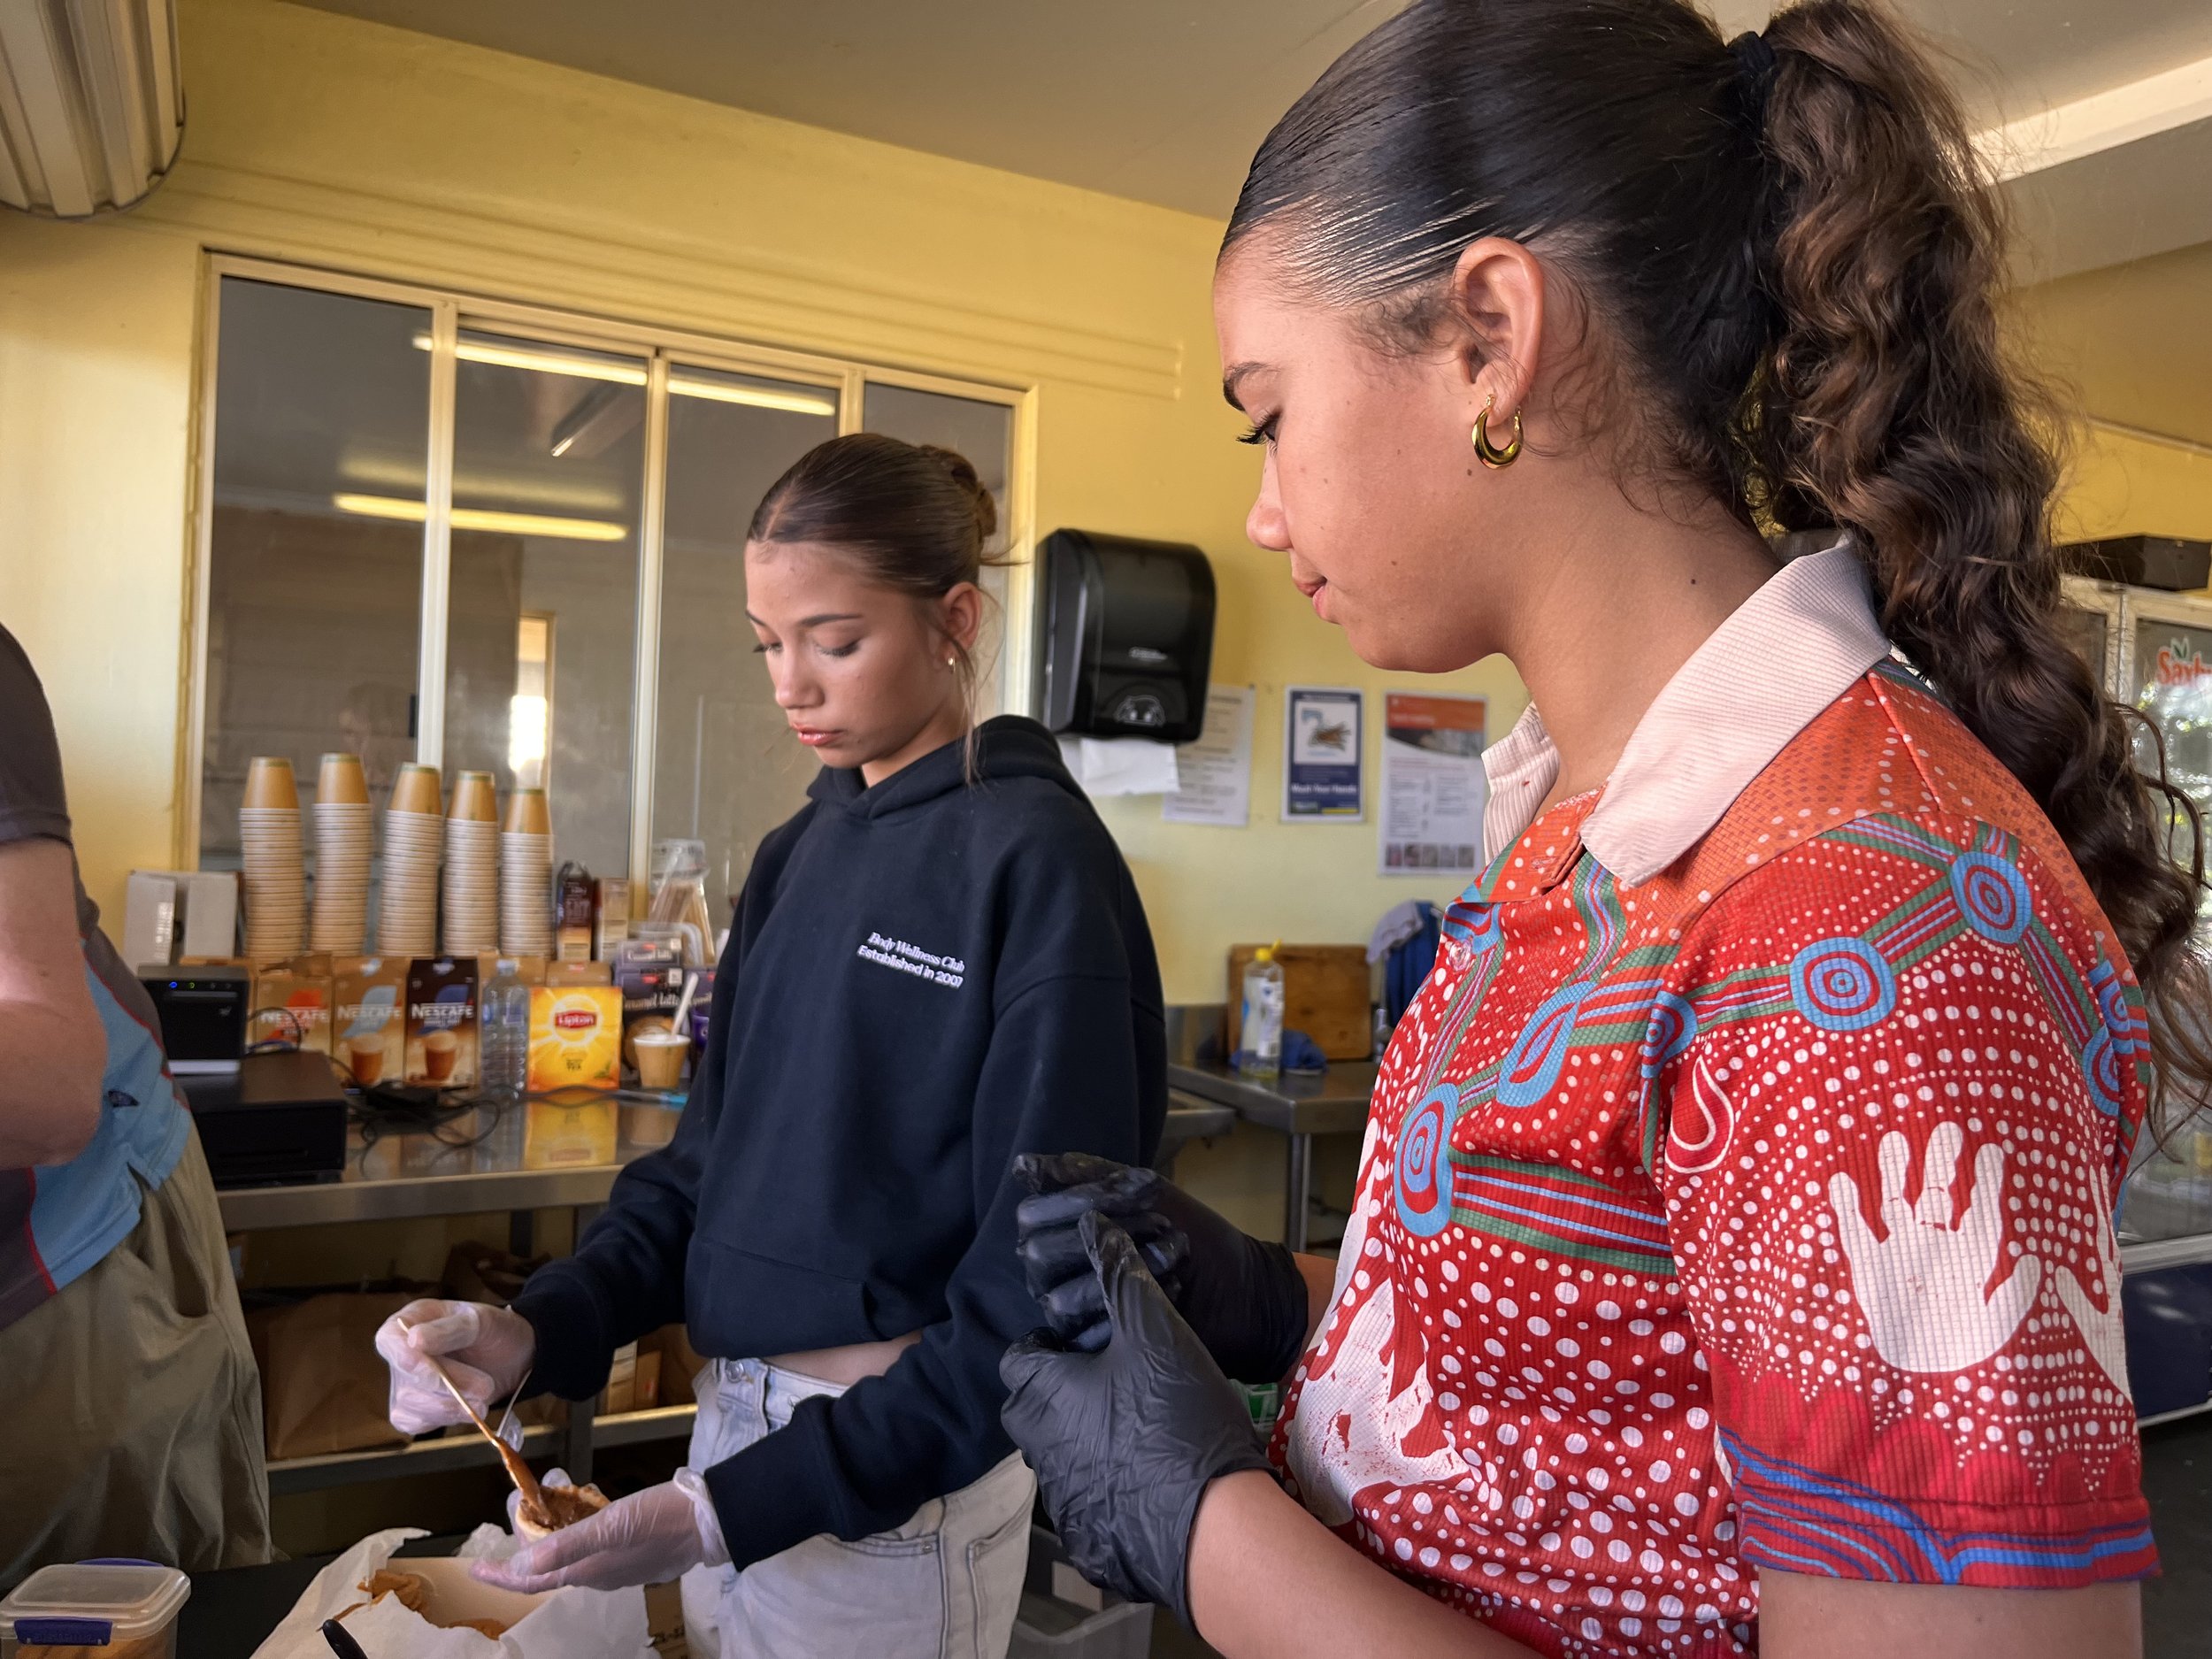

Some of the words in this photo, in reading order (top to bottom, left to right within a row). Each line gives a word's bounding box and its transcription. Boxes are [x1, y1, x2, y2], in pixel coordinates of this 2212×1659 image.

[856, 944, 924, 976] Established
[924, 965, 934, 979] in
[867, 932, 896, 951] Body
[895, 941, 941, 966] Wellness
[941, 956, 965, 973] Club
[557, 1012, 595, 1026] Lipton
